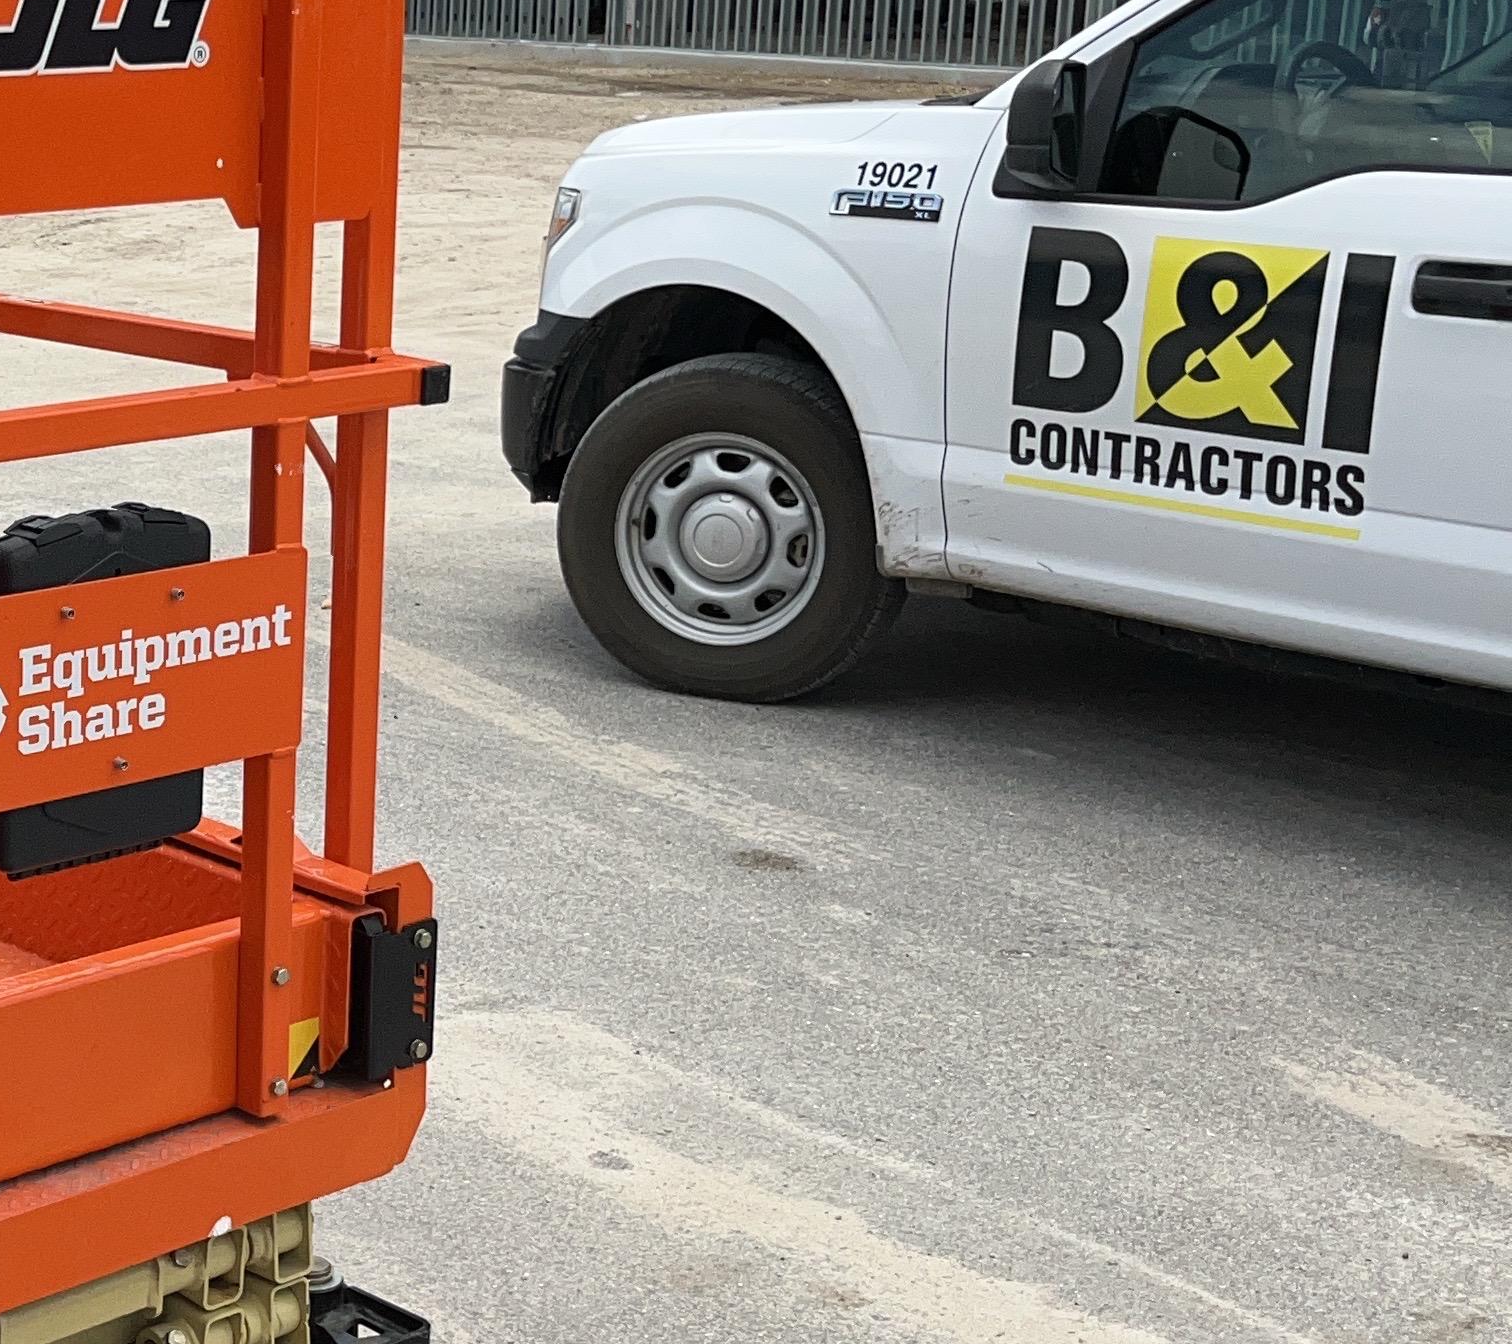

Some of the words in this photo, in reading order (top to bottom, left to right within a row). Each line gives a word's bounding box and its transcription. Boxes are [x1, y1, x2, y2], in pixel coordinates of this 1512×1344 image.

[857, 161, 938, 190] 19021
[1012, 225, 1397, 455] B&I
[1008, 417, 1366, 517] CONTRACTORS
[18, 604, 292, 698] Equipment
[17, 692, 166, 756] Share
